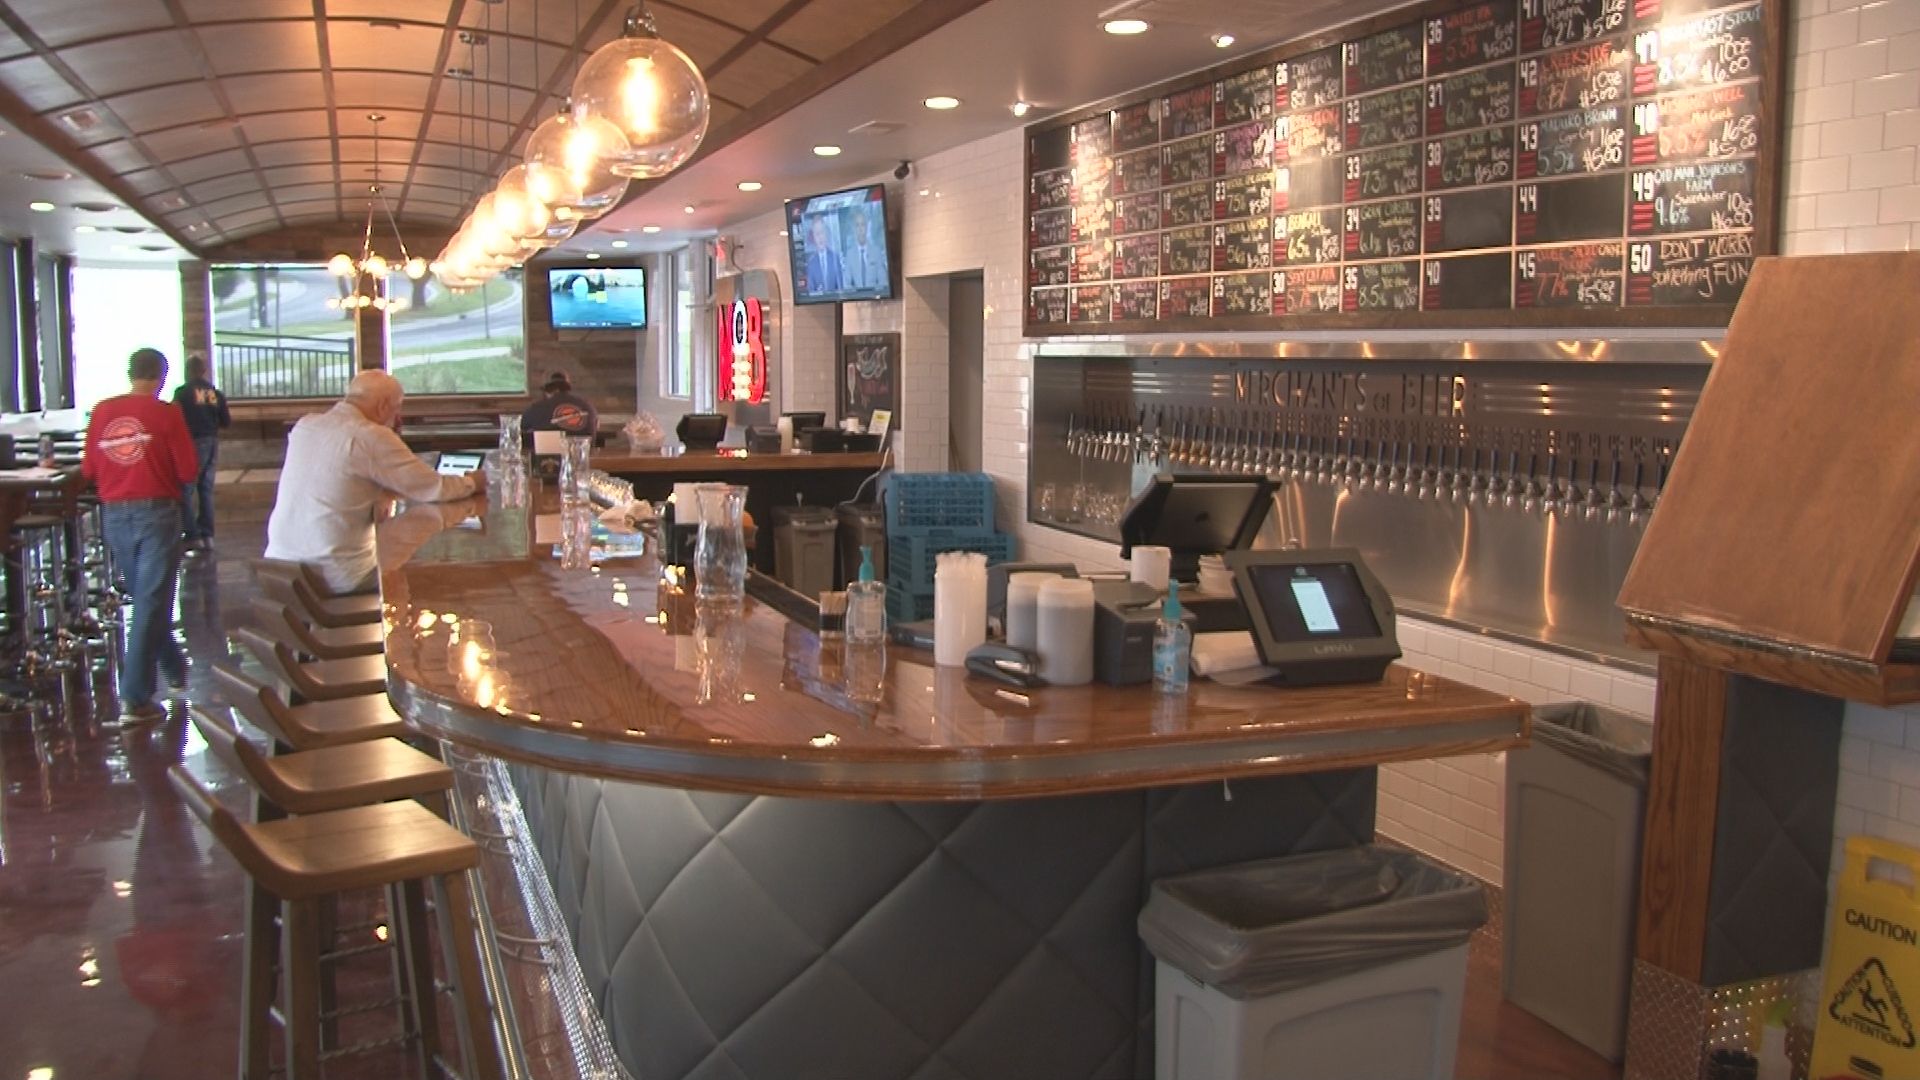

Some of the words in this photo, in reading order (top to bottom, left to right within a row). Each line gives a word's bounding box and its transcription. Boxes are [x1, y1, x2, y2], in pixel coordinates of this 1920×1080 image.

[1428, 19, 1442, 45] 36
[1347, 43, 1358, 65] 31
[1520, 60, 1537, 87] 42
[1428, 83, 1442, 107] 37
[1347, 101, 1359, 123] 32
[1584, 108, 1617, 126] BROWN
[1520, 125, 1537, 151] 43
[1347, 157, 1360, 179] 33
[1674, 165, 1695, 181] MAN
[1519, 185, 1536, 212] 44
[1632, 172, 1655, 201] 49
[1346, 208, 1359, 231] 34
[1427, 199, 1441, 221] 39
[1518, 253, 1535, 278] 45
[1630, 244, 1651, 273] 50
[1345, 267, 1358, 289] 35
[1426, 261, 1440, 285] 40
[1713, 259, 1749, 285] FUN
[1402, 373, 1465, 417] BEER
[1845, 908, 1917, 946] CAUTION
